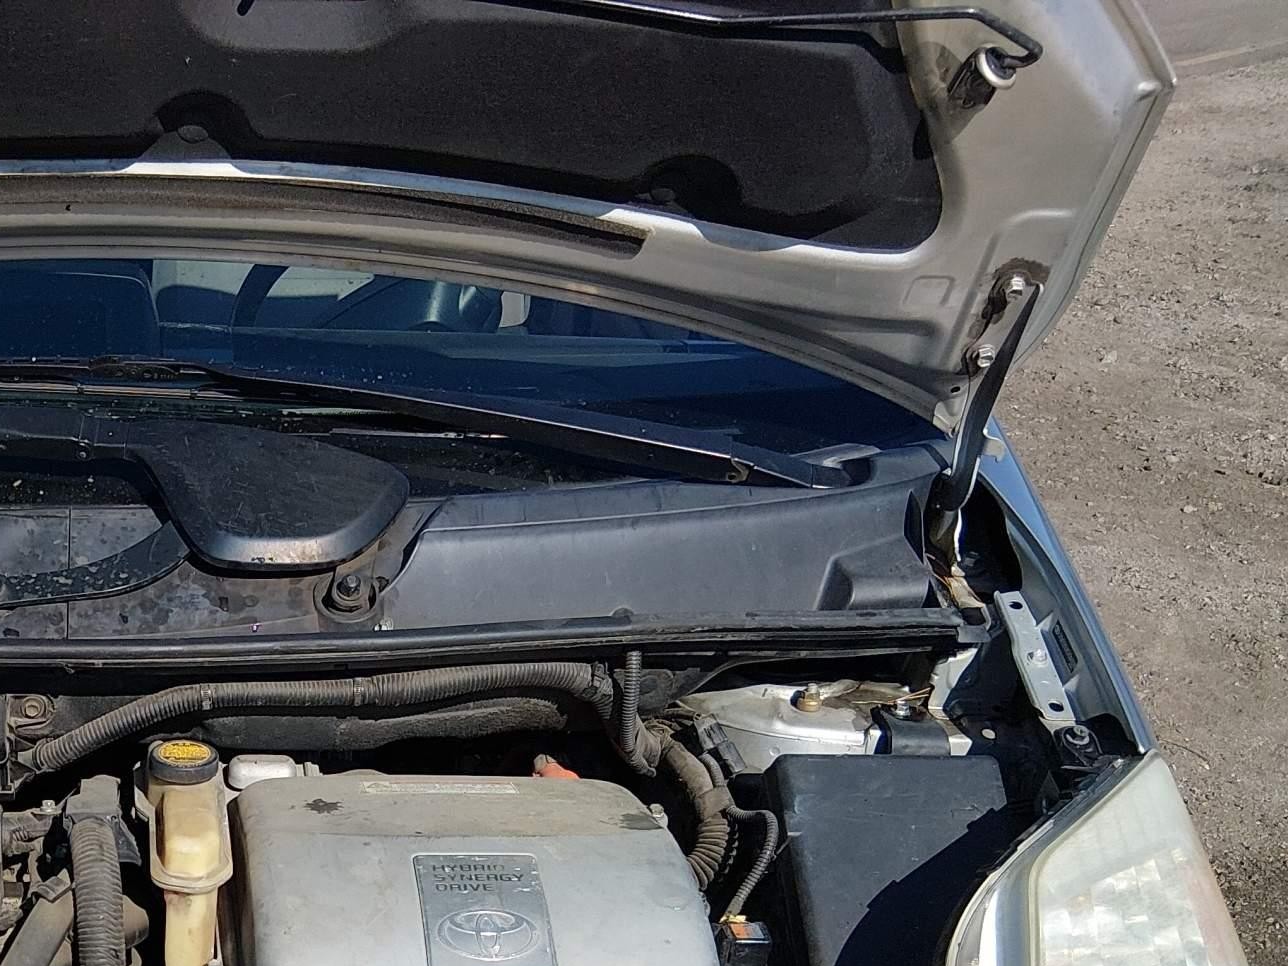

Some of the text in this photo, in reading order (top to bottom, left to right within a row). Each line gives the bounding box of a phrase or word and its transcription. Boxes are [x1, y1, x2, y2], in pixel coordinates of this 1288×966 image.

[432, 863, 505, 872] HYBRID
[433, 873, 525, 882] SYNERGY
[435, 883, 496, 892] DRIVE
